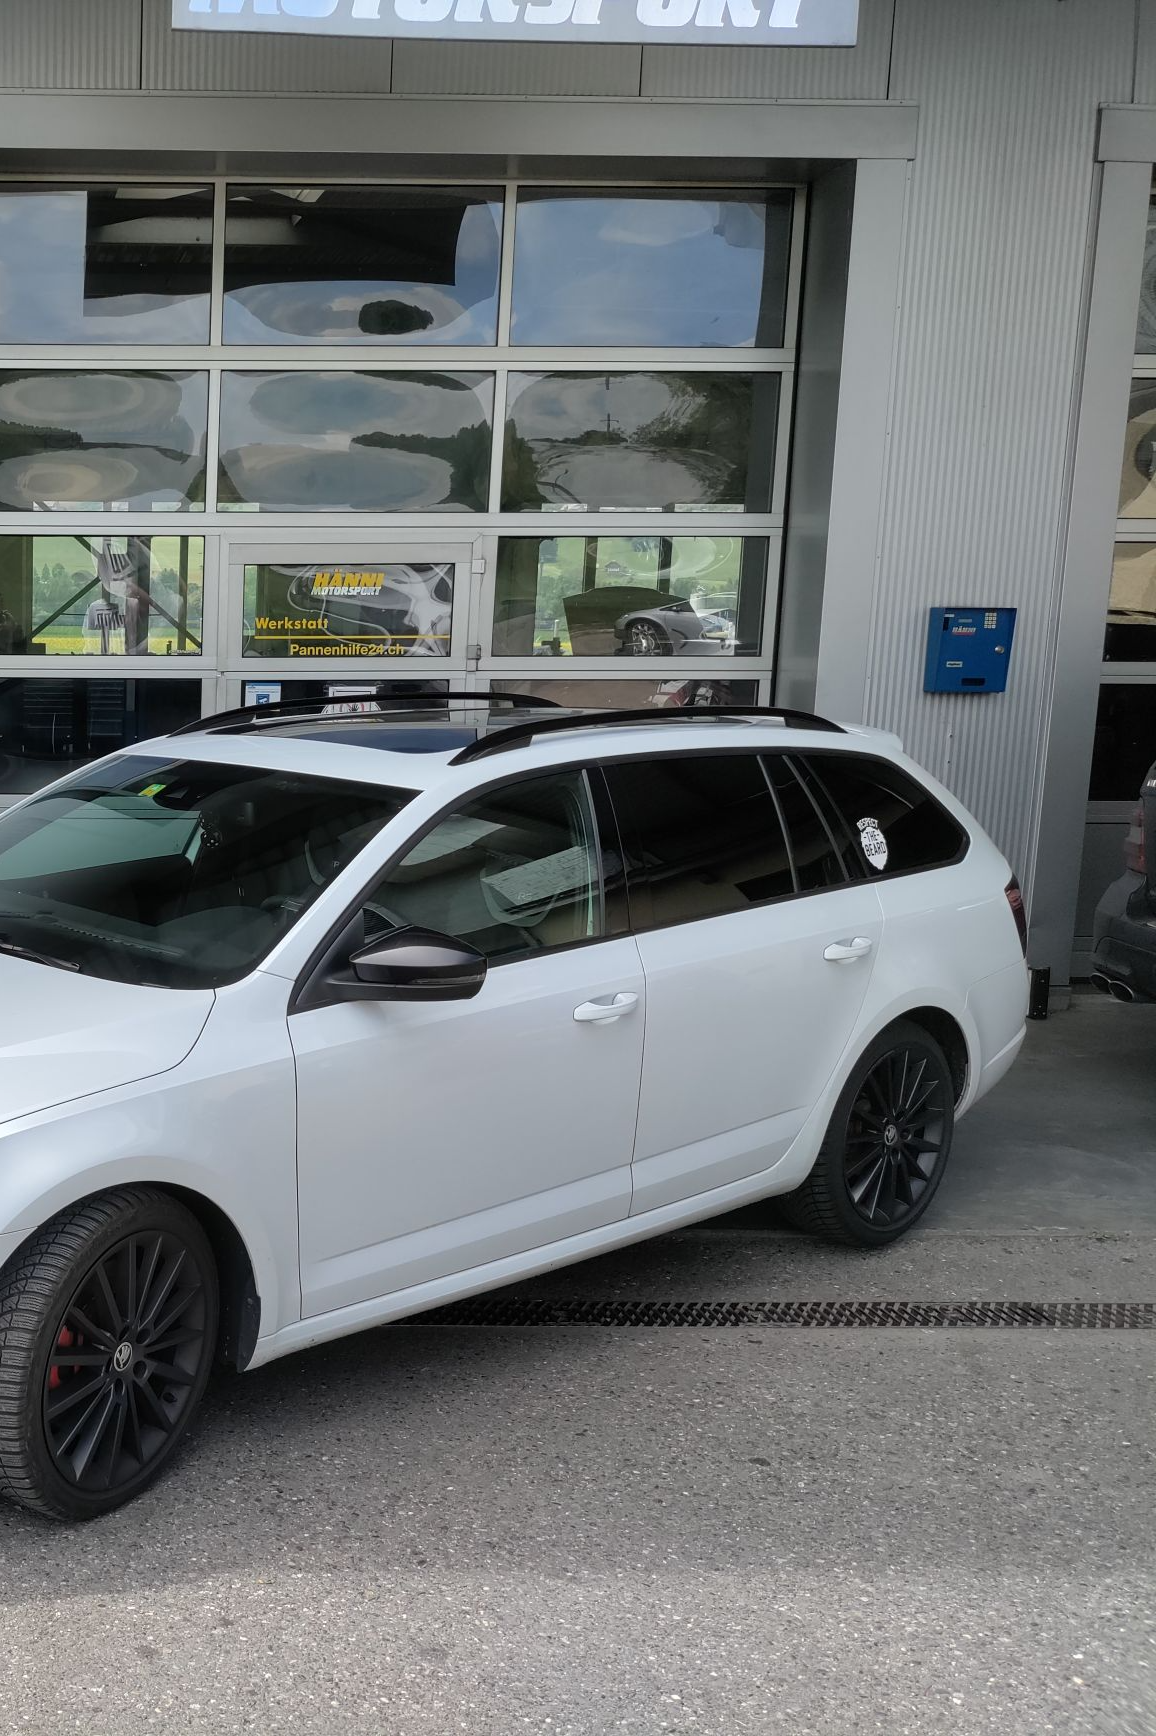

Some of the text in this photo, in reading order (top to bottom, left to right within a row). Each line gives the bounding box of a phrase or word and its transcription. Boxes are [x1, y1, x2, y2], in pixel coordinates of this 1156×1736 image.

[313, 569, 385, 587] HÄNNI
[311, 586, 382, 596] MOTORSPORT
[255, 617, 328, 629] Werkstatt
[290, 644, 404, 656] Pannenhilfe24.ch
[856, 818, 878, 830] RESPECT
[865, 841, 886, 856] BEARD
